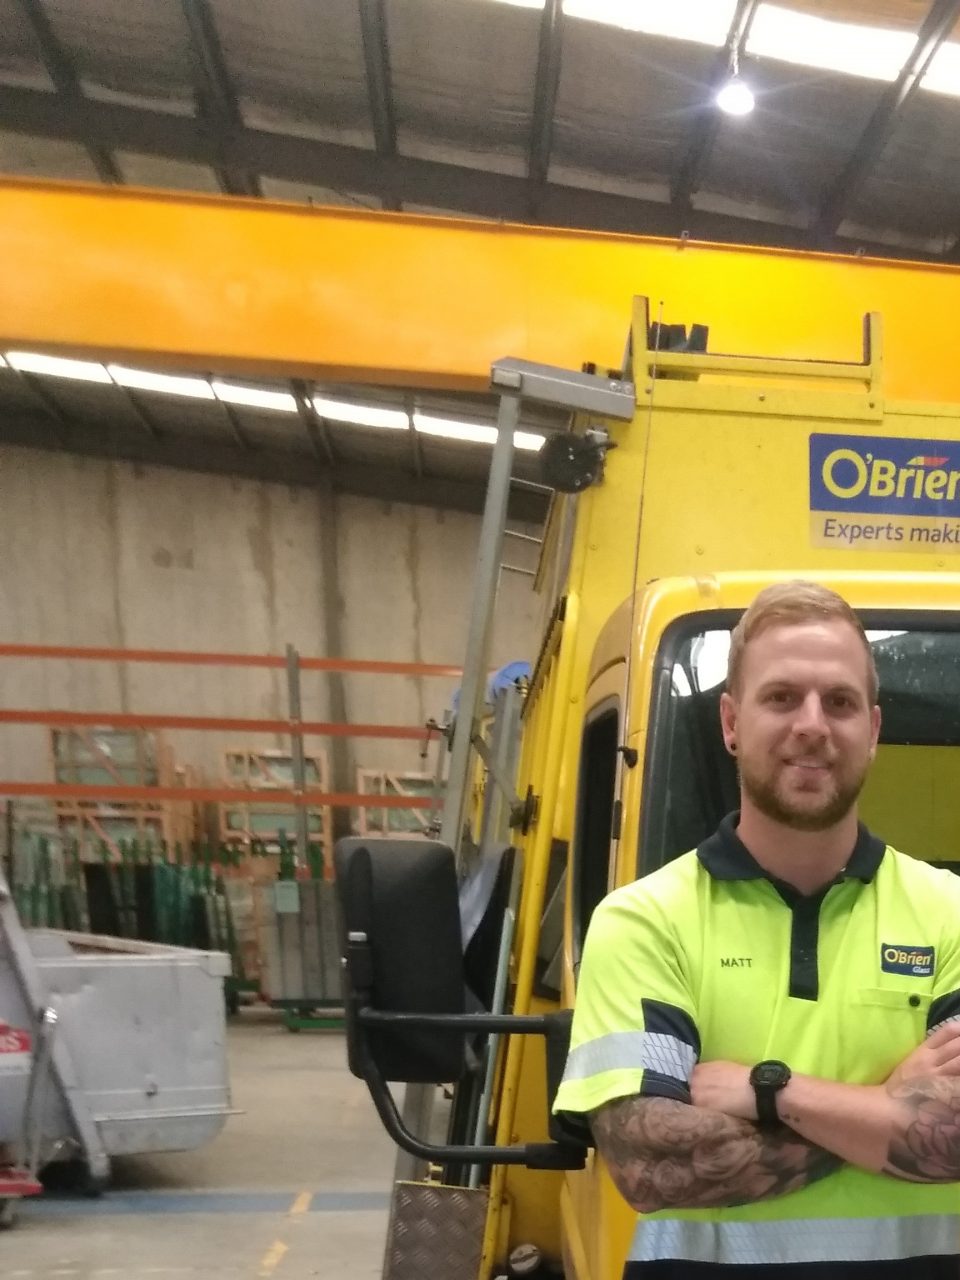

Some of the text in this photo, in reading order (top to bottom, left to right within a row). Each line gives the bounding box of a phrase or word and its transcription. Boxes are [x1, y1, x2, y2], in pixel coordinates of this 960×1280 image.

[823, 518, 904, 543] Experts
[720, 958, 752, 968] MATT
[884, 948, 931, 966] O'Brien
